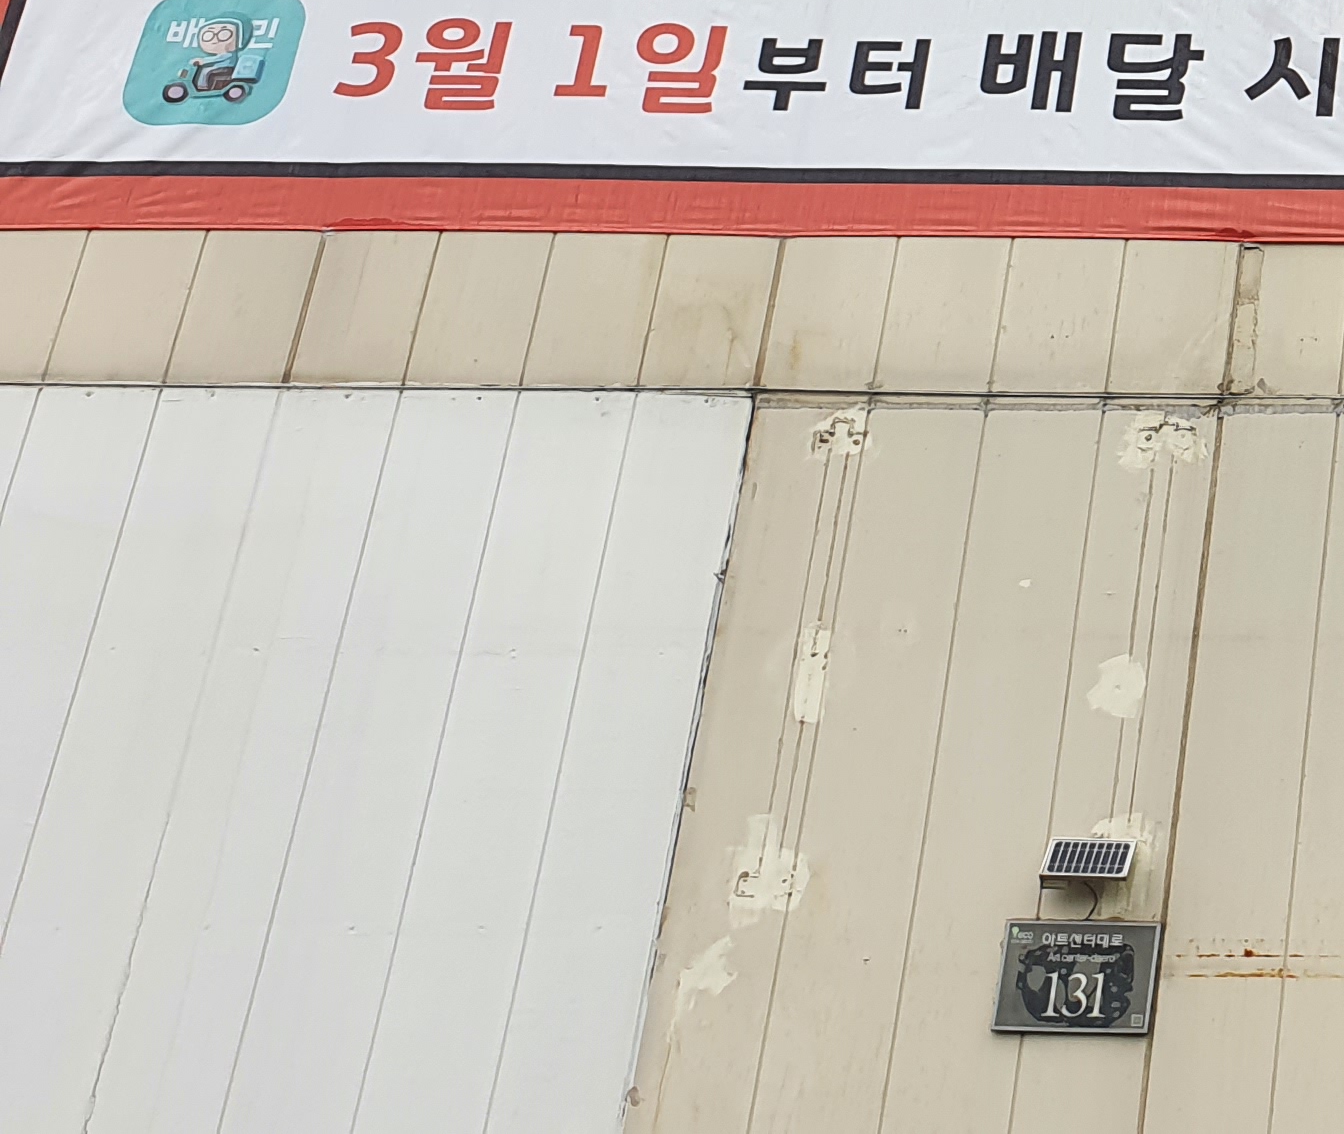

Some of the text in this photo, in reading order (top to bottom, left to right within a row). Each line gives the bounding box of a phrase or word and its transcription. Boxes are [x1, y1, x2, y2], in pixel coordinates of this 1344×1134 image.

[333, 18, 512, 112] 3월
[979, 31, 1206, 122] 배달
[1042, 932, 1124, 948] 아트센터대로
[1041, 972, 1106, 1018] 131
